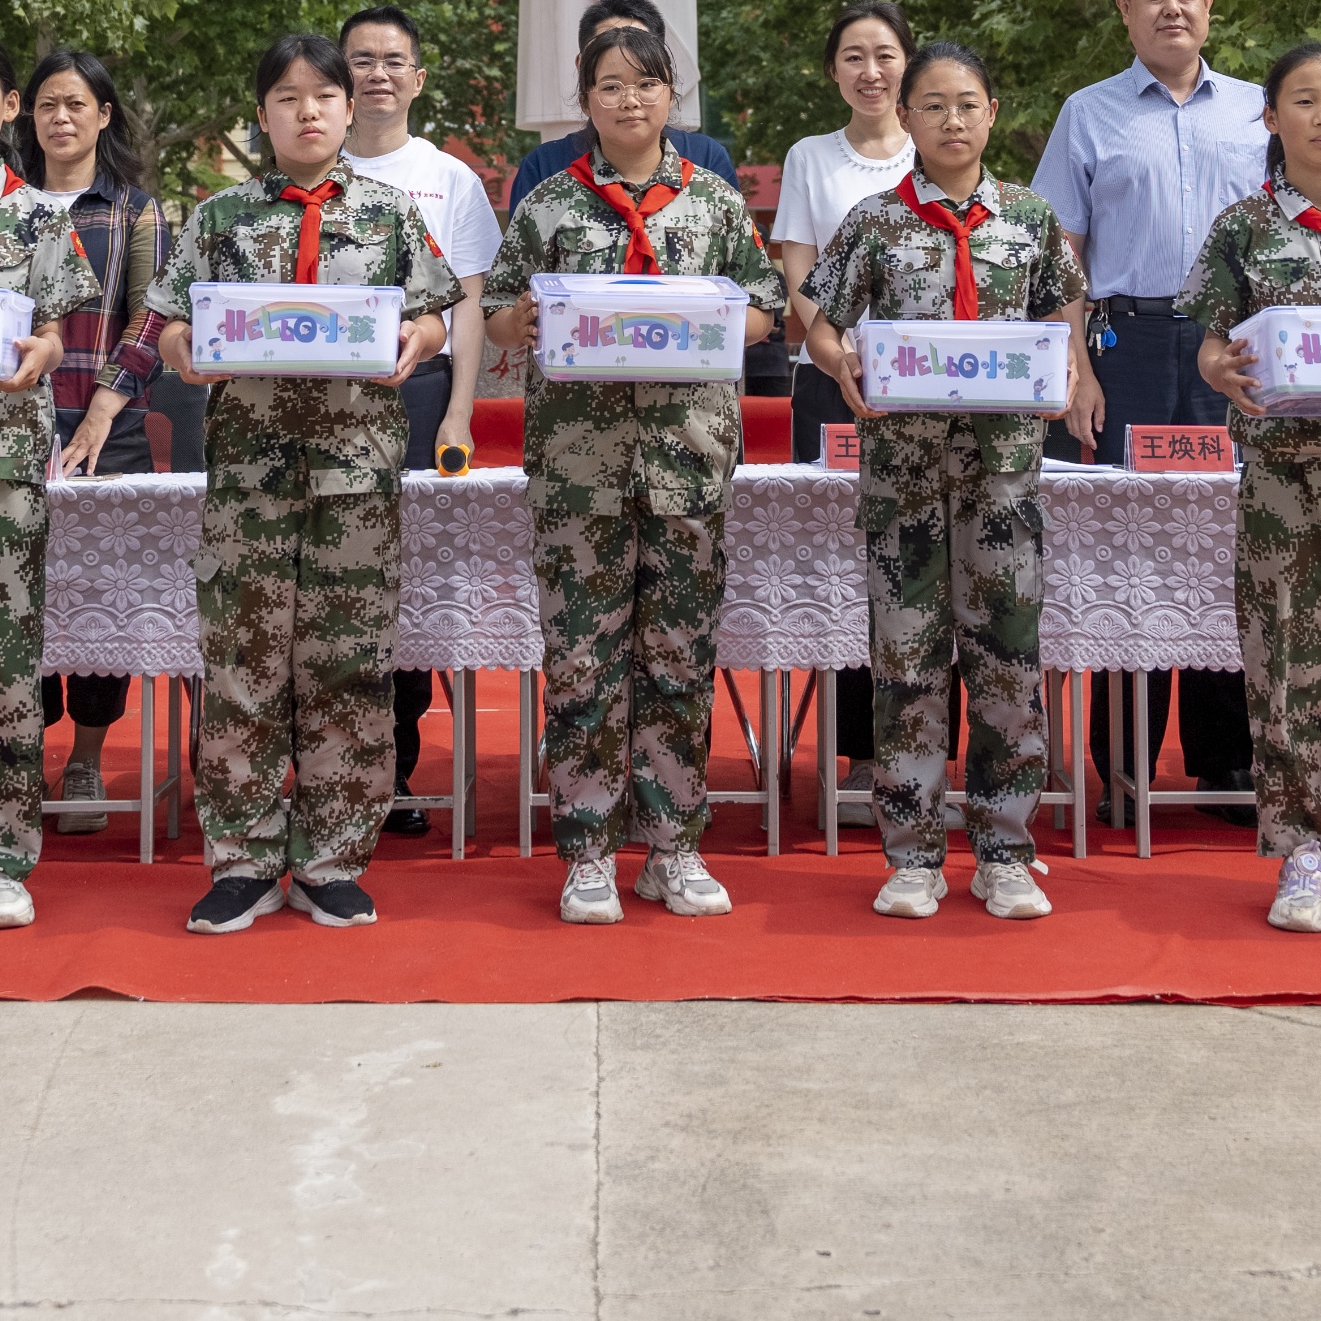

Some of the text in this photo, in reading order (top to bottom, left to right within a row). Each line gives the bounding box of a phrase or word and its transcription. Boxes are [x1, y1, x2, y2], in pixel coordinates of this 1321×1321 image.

[488, 349, 526, 381] 好
[835, 435, 860, 458] 王
[1139, 434, 1225, 462] 王焕科
